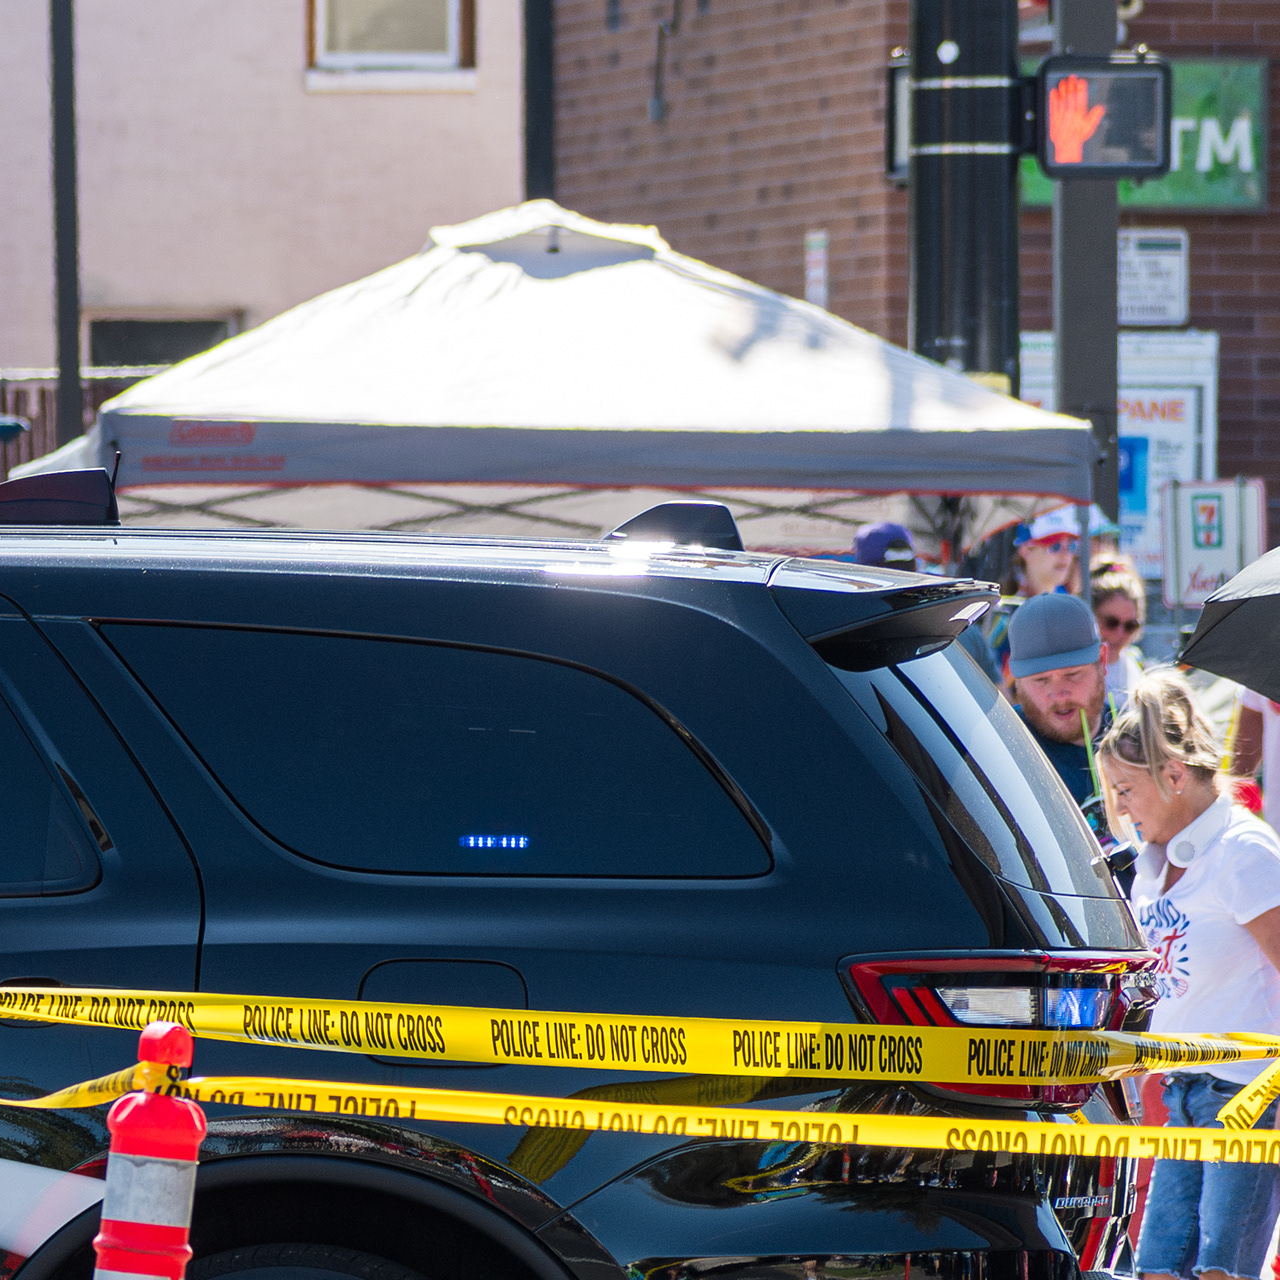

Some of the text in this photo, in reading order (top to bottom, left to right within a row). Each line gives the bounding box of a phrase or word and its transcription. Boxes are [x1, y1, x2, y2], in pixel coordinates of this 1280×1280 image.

[1171, 117, 1254, 173] TM
[1118, 400, 1185, 422] PANE
[243, 1005, 445, 1053] POLICE LINE: DO NOT CROSS
[490, 1019, 687, 1065] POLICE LINE: DO NOT CROSS
[733, 1030, 923, 1074] POLICE LINE: DO NOT CROSS
[967, 1038, 1015, 1077] POLICE
[1019, 1040, 1049, 1077] LINE:
[1049, 1041, 1065, 1078] DO
[1062, 1041, 1083, 1077] NOT
